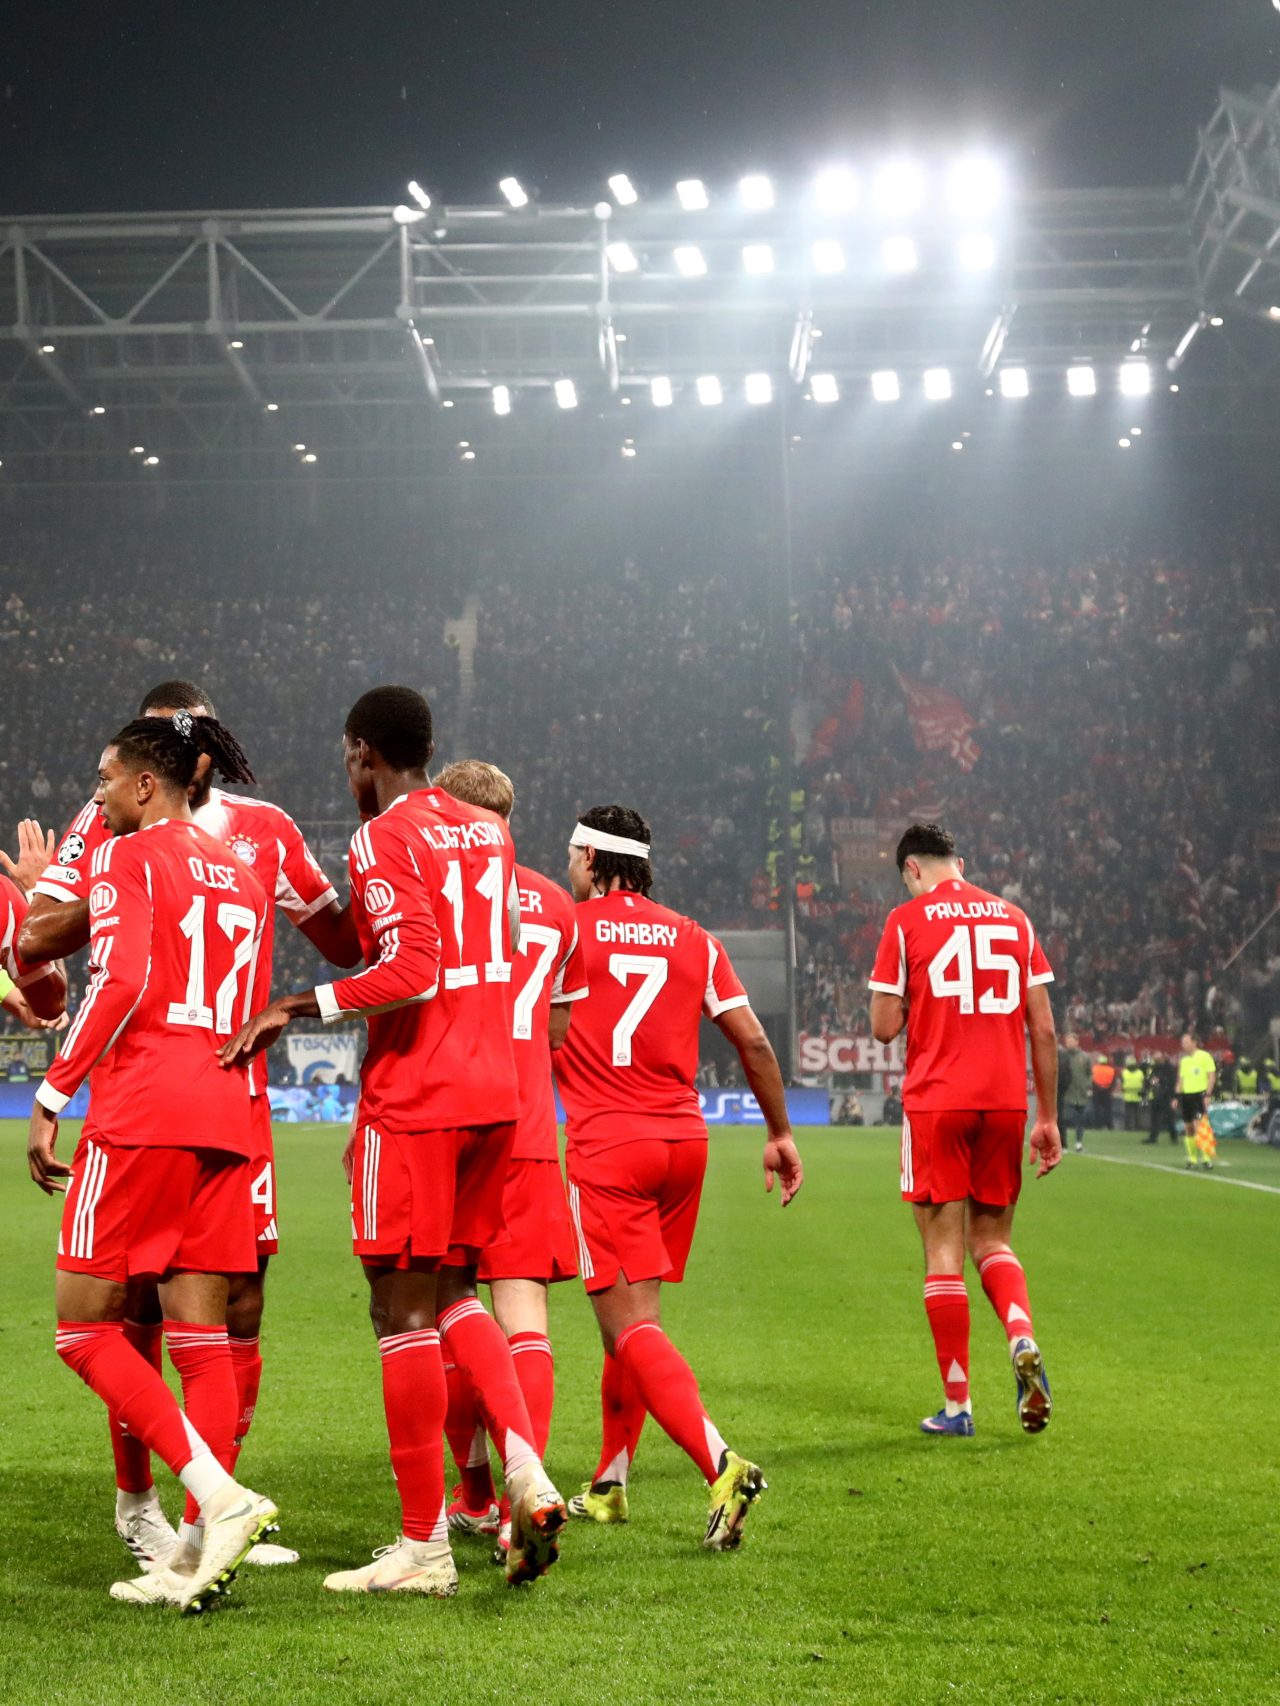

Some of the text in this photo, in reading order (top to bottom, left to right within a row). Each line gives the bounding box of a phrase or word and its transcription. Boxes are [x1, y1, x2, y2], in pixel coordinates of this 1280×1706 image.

[188, 856, 239, 893] OLISE
[372, 912, 403, 934] Allianz
[441, 856, 512, 990] 11
[596, 919, 678, 948] GNABRY
[166, 895, 257, 1035] 17
[927, 924, 1021, 1015] 45
[608, 953, 669, 1067] 7
[250, 1161, 273, 1215] 4
